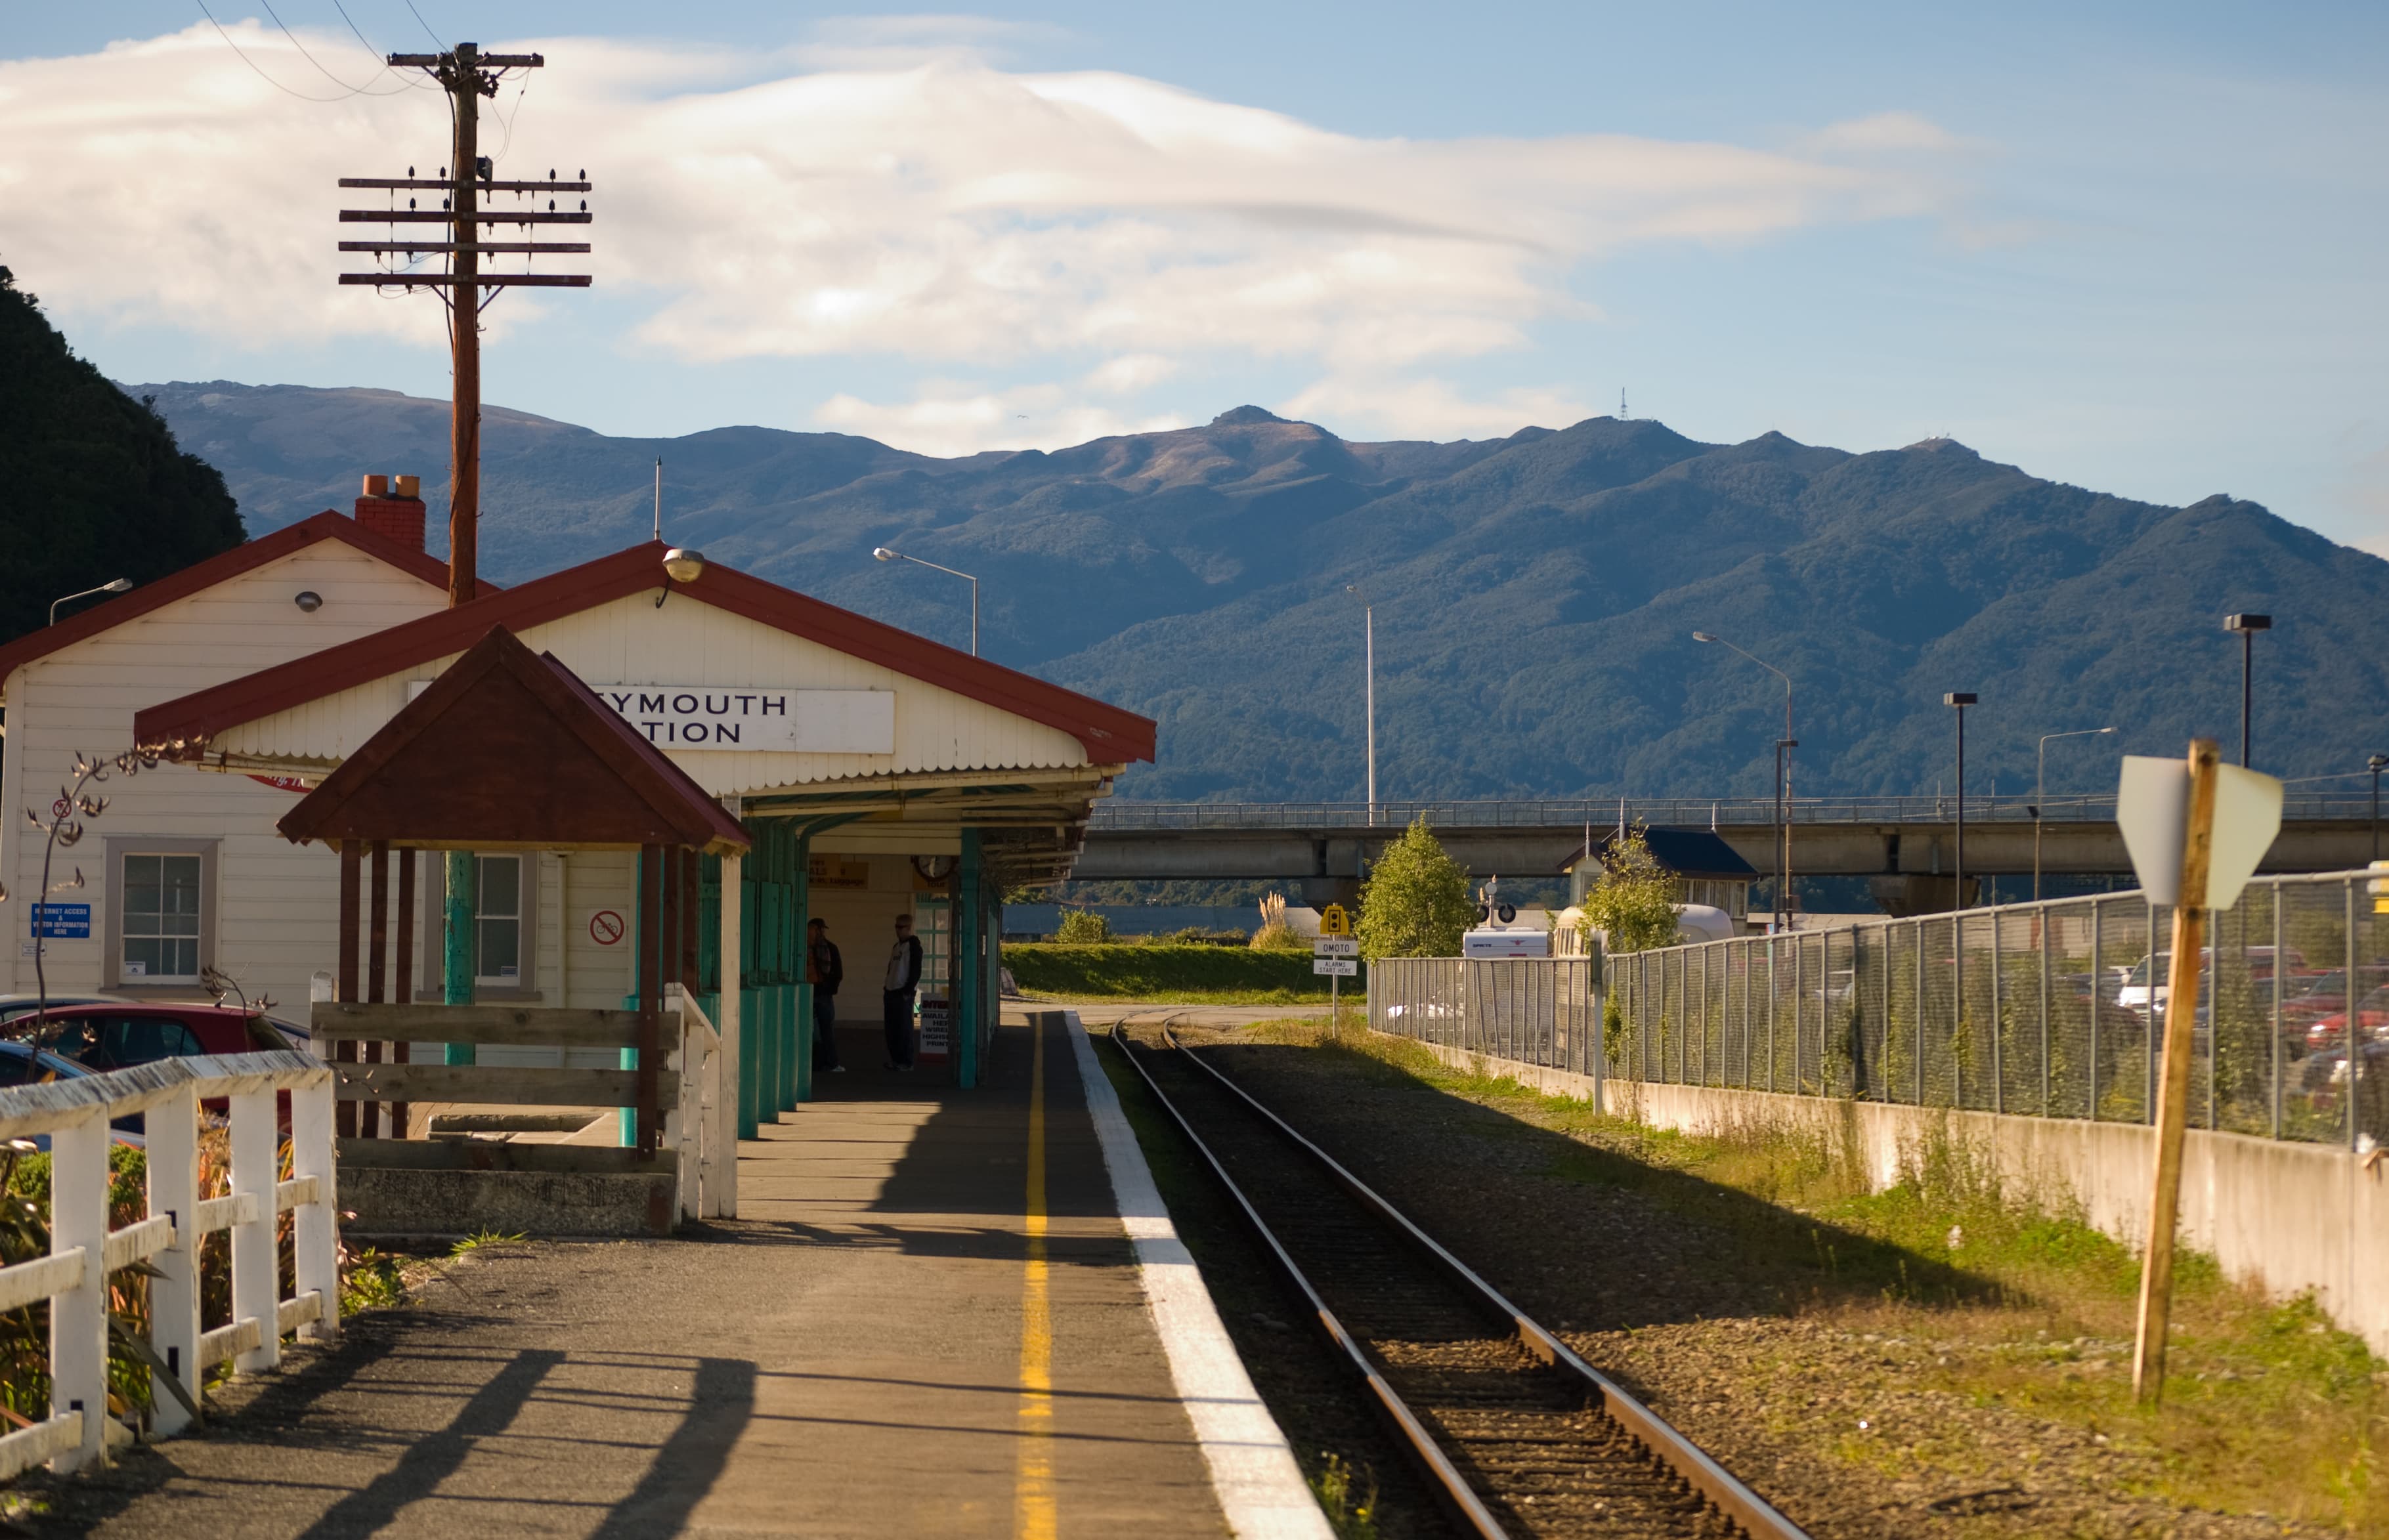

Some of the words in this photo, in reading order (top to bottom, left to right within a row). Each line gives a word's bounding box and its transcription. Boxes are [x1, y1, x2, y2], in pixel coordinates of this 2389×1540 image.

[595, 693, 786, 716] YMOUTH
[628, 721, 741, 743] TION
[1323, 944, 1350, 952] OMOTO
